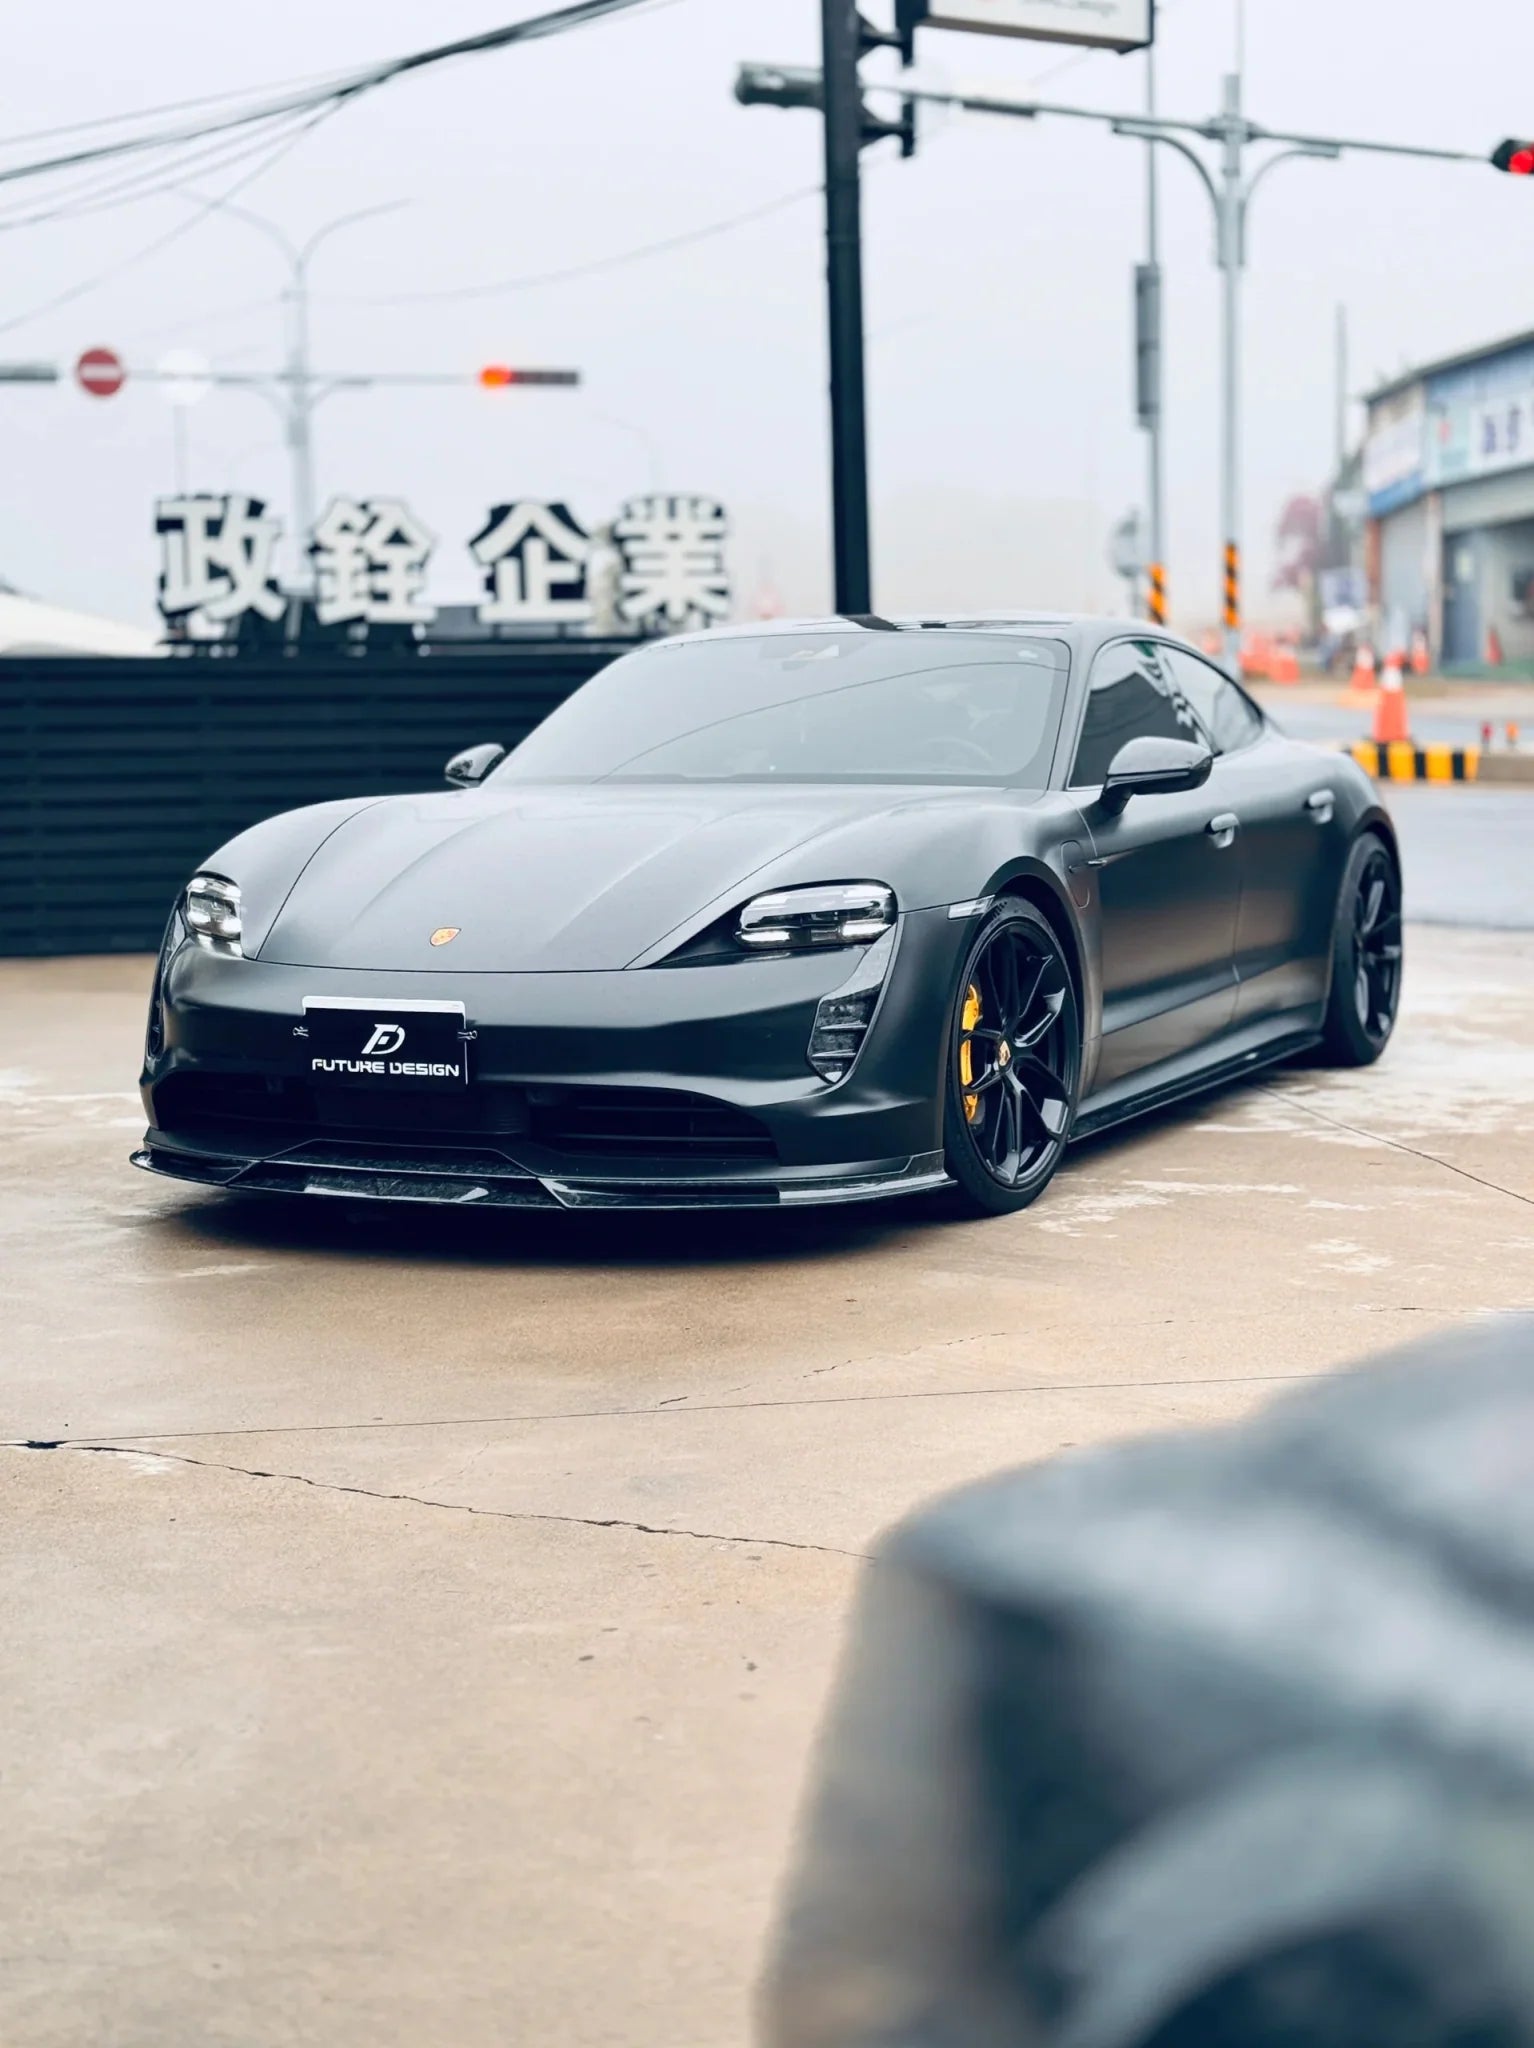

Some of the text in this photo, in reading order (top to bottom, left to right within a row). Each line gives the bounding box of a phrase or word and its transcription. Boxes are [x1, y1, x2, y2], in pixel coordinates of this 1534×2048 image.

[156, 493, 730, 625] 政銓企業
[311, 1058, 460, 1077] FUTURE DESIGN
